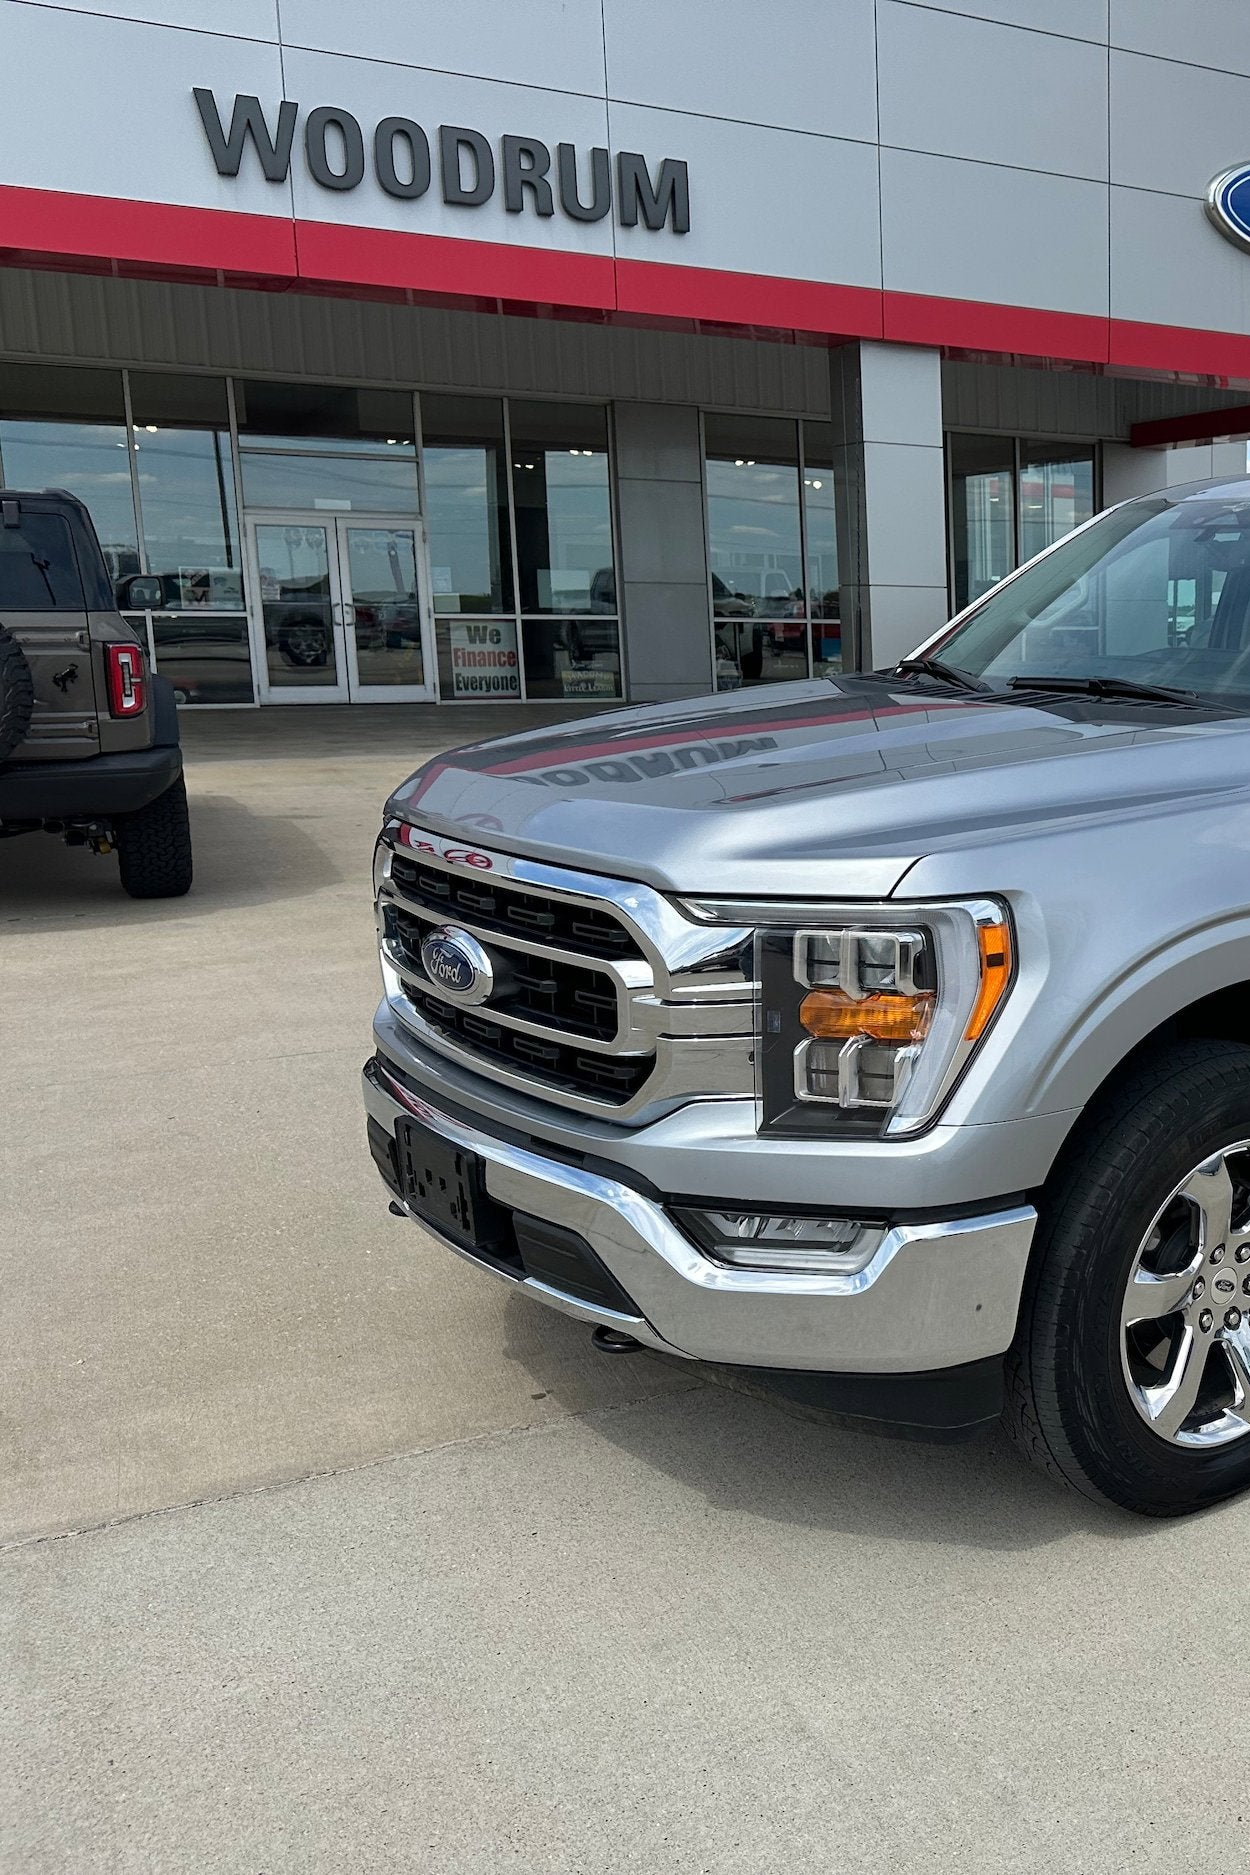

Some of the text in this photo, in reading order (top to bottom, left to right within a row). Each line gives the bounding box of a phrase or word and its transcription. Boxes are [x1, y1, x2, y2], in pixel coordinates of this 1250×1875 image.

[192, 87, 691, 234] WOODRUM
[466, 625, 502, 645] We
[453, 647, 517, 668] Finance
[455, 672, 518, 693] Everyone
[430, 946, 464, 984] Ford
